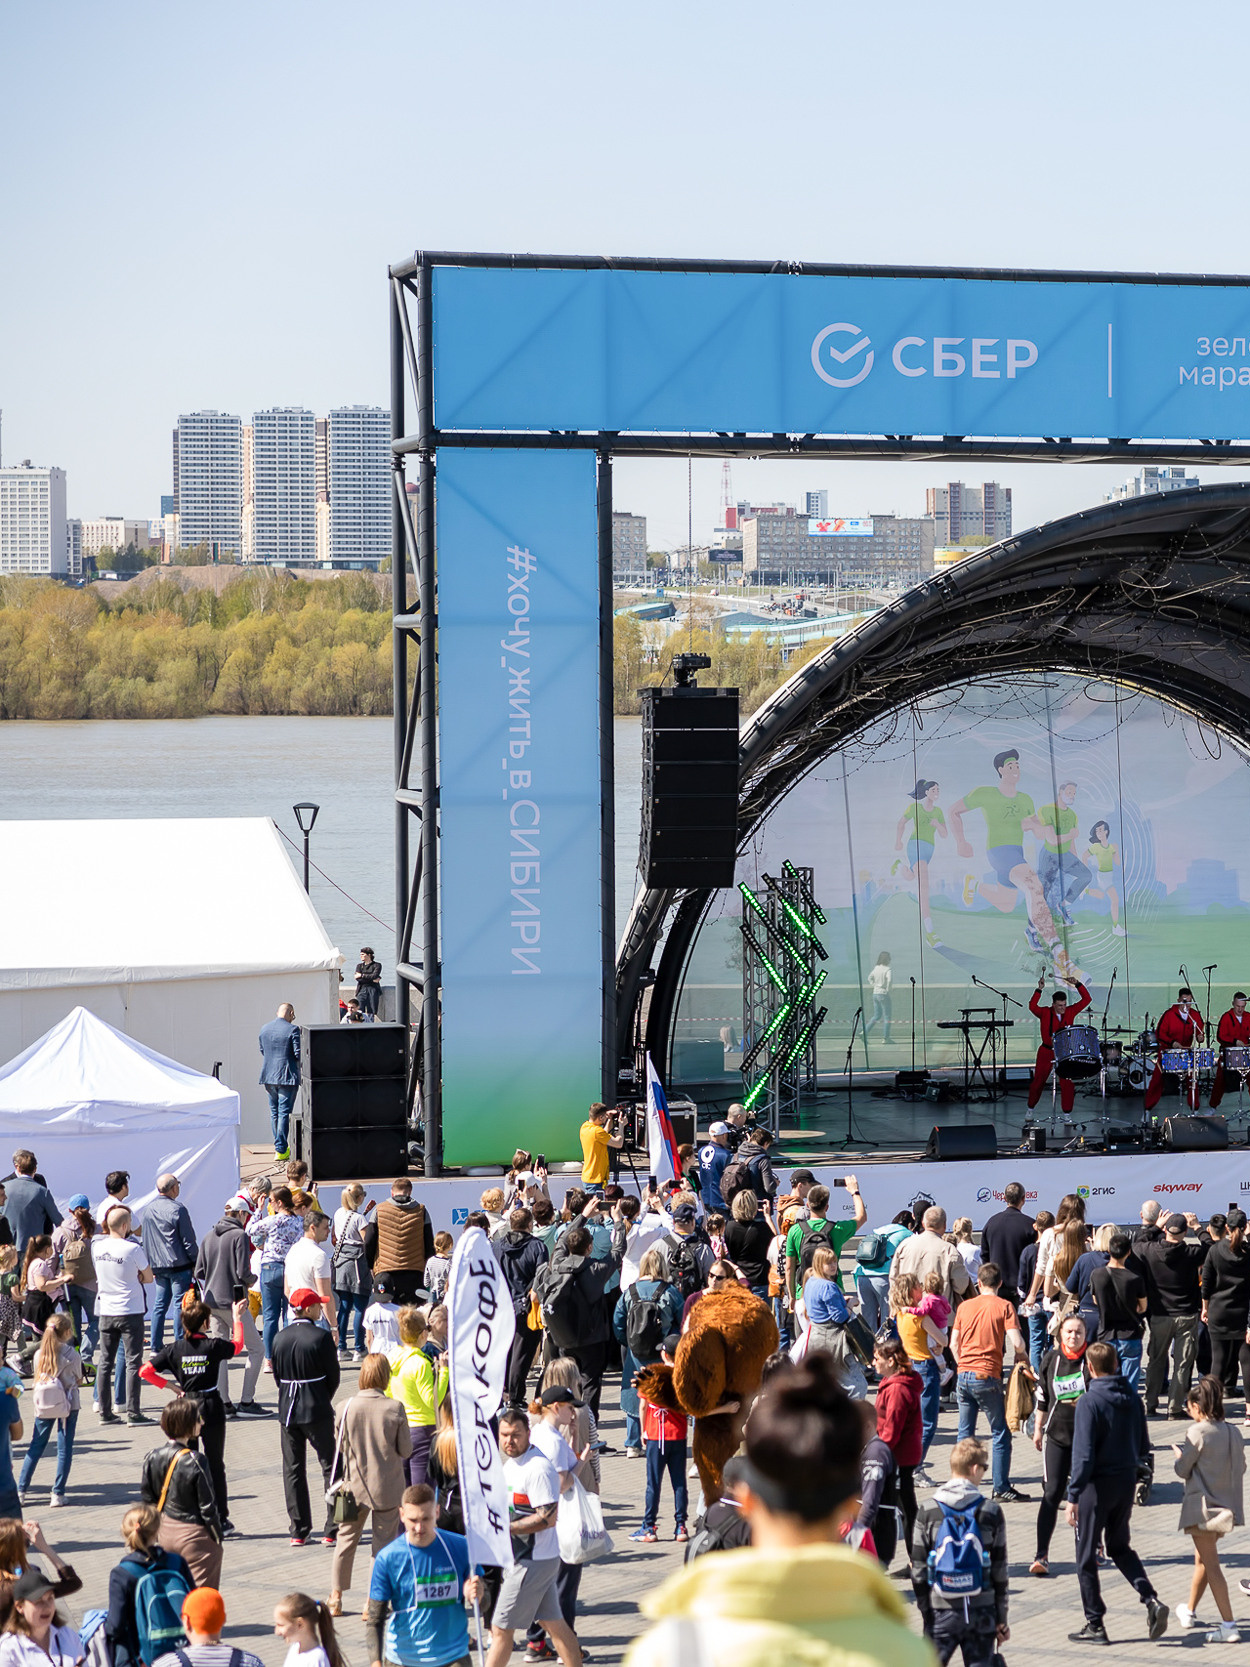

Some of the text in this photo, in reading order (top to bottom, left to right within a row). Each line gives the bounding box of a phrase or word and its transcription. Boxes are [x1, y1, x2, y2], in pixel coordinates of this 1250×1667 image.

[892, 336, 1038, 379] СБЕР
[1092, 1187, 1115, 1195] 2ГИС
[1152, 1183, 1203, 1194] skyway
[424, 1585, 451, 1598] 1287
